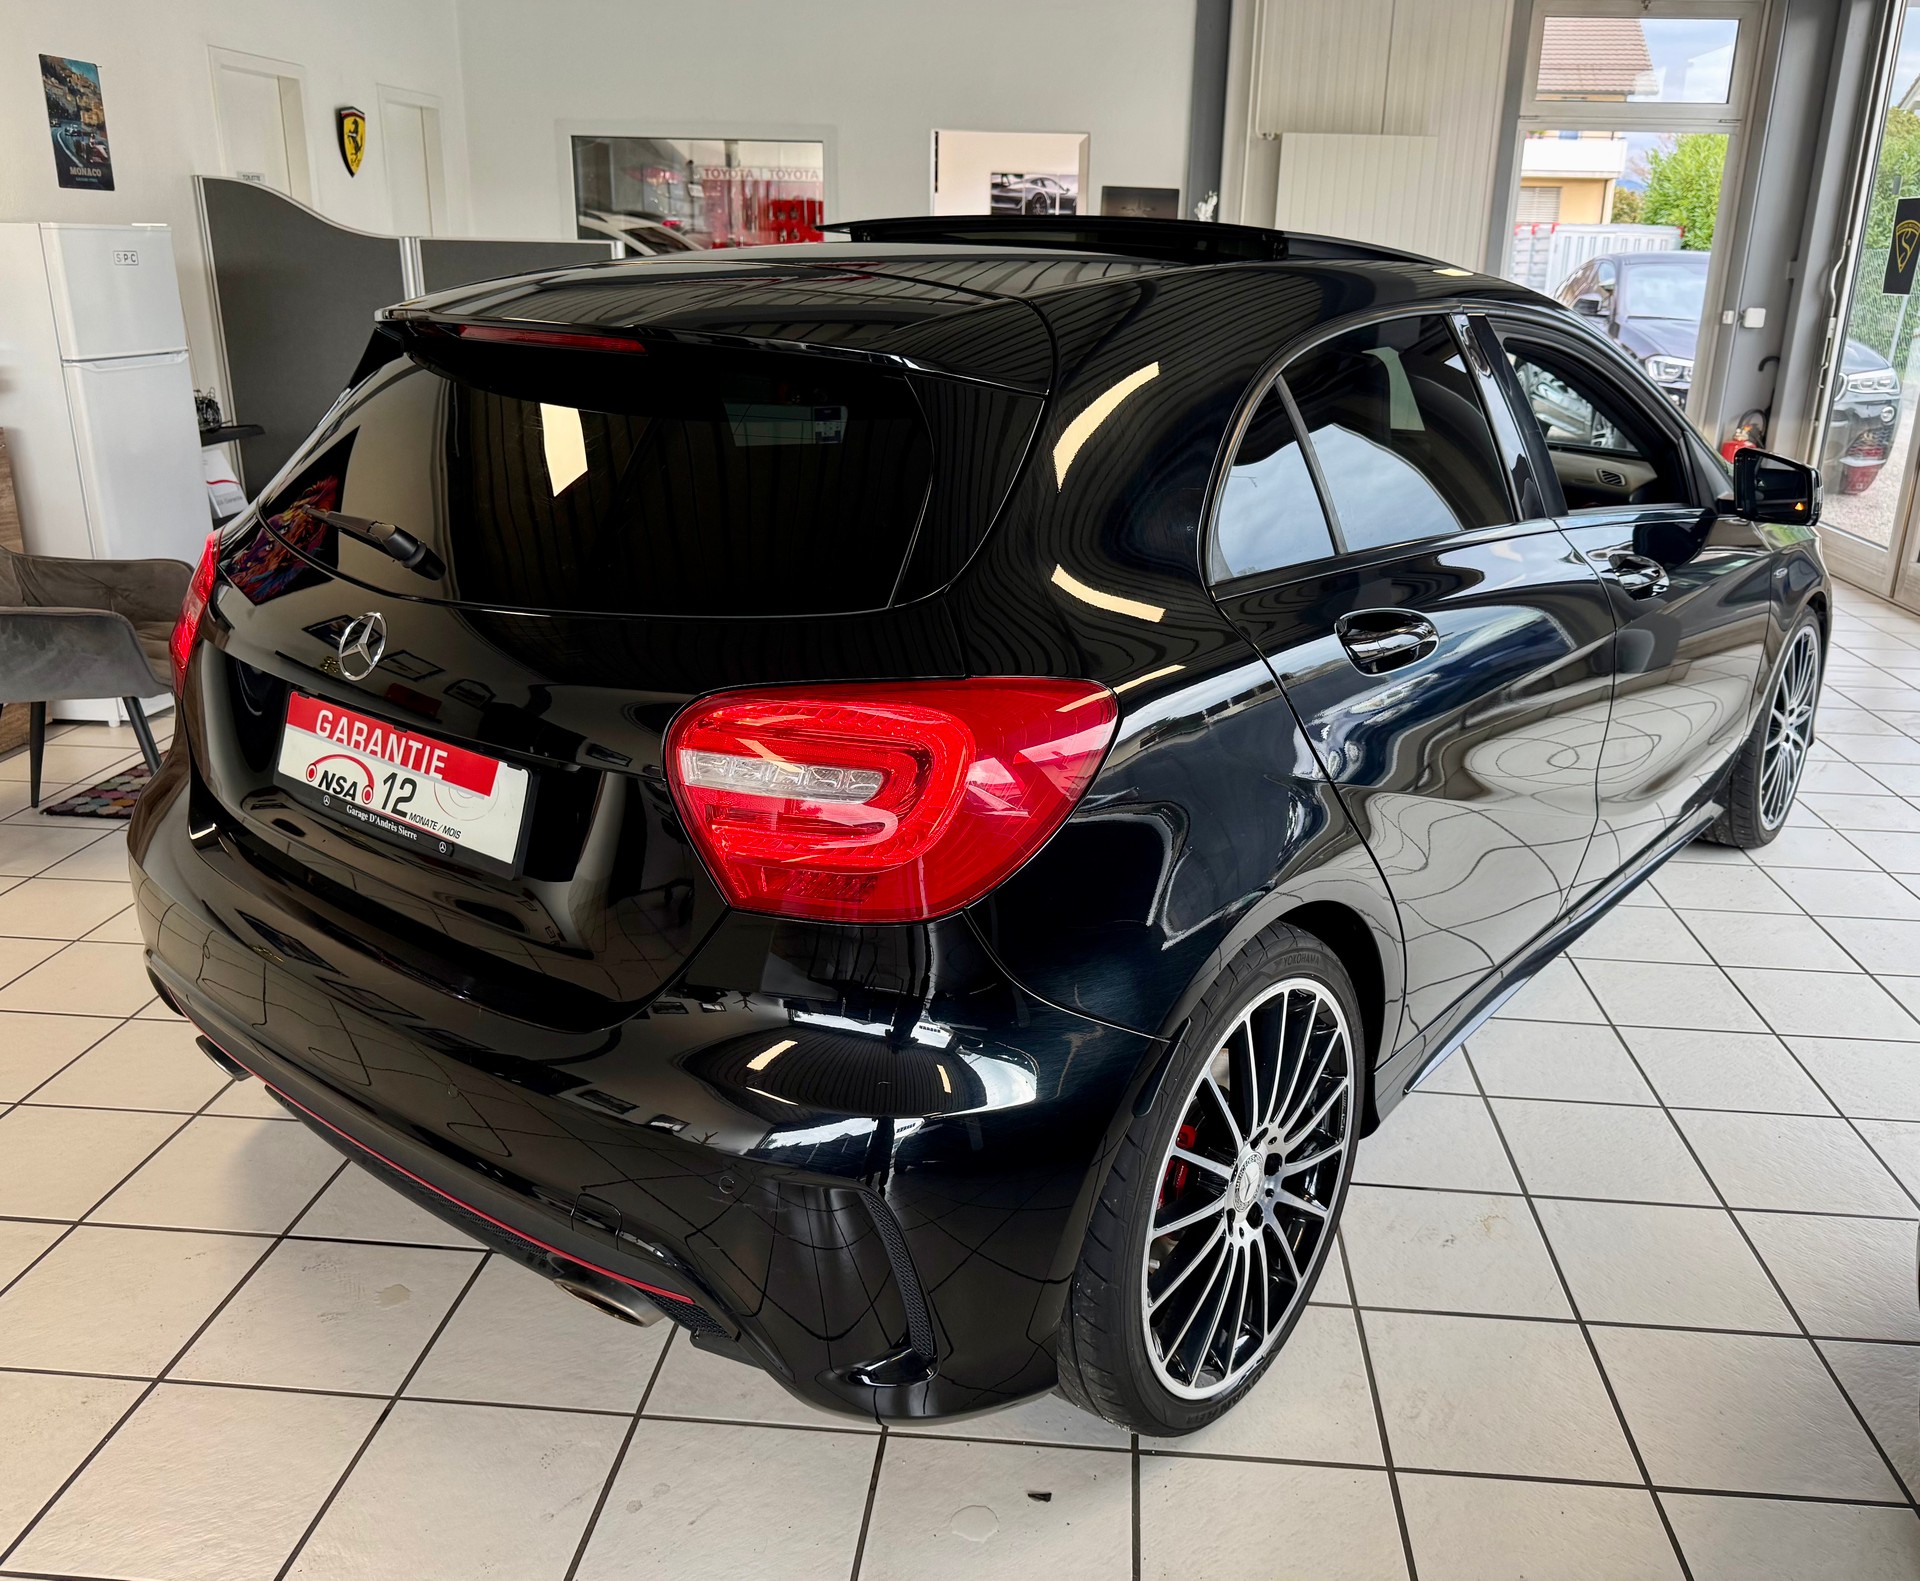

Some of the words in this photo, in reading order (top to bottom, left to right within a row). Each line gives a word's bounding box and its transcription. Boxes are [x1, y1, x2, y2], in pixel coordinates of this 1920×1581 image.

[69, 166, 102, 177] MONACO
[704, 168, 754, 180] TOYOTA
[768, 169, 819, 180] TOYOTA
[315, 709, 448, 780] GARANTIE
[317, 769, 358, 801] NSA
[381, 772, 418, 819] 12
[408, 812, 439, 830] MONATE
[442, 824, 462, 840] MOIS
[346, 804, 369, 822] Garage
[398, 823, 418, 841] Sierre
[1283, 952, 1320, 966] YOKOHAMA
